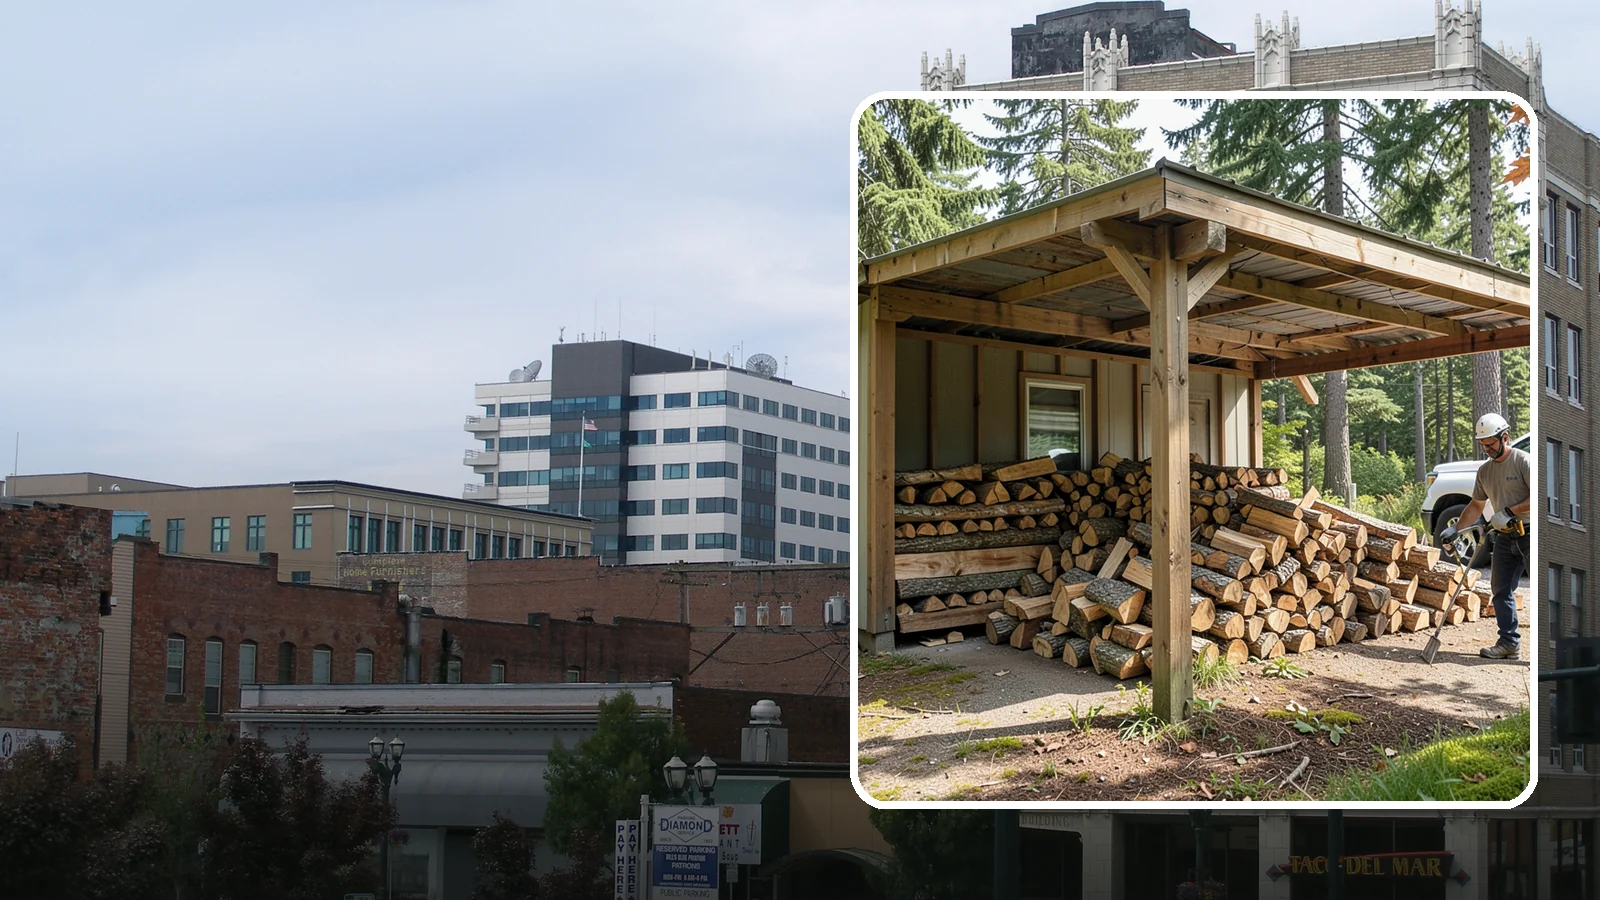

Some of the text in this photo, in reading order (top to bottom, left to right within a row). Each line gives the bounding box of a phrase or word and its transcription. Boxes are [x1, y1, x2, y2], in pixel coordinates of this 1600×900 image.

[343, 566, 427, 577] Home Furnishers
[660, 818, 713, 833] DIAMOND
[1022, 815, 1070, 828] BUILDING
[656, 845, 716, 854] RESERVED PARKING
[616, 825, 625, 894] PAY HERE
[628, 824, 637, 894] PAY HERE
[722, 852, 739, 862] Soup
[671, 862, 701, 870] PATRONS
[1289, 855, 1442, 877] TAC DEL MAR
[660, 888, 710, 898] PUBLIC PARKING
